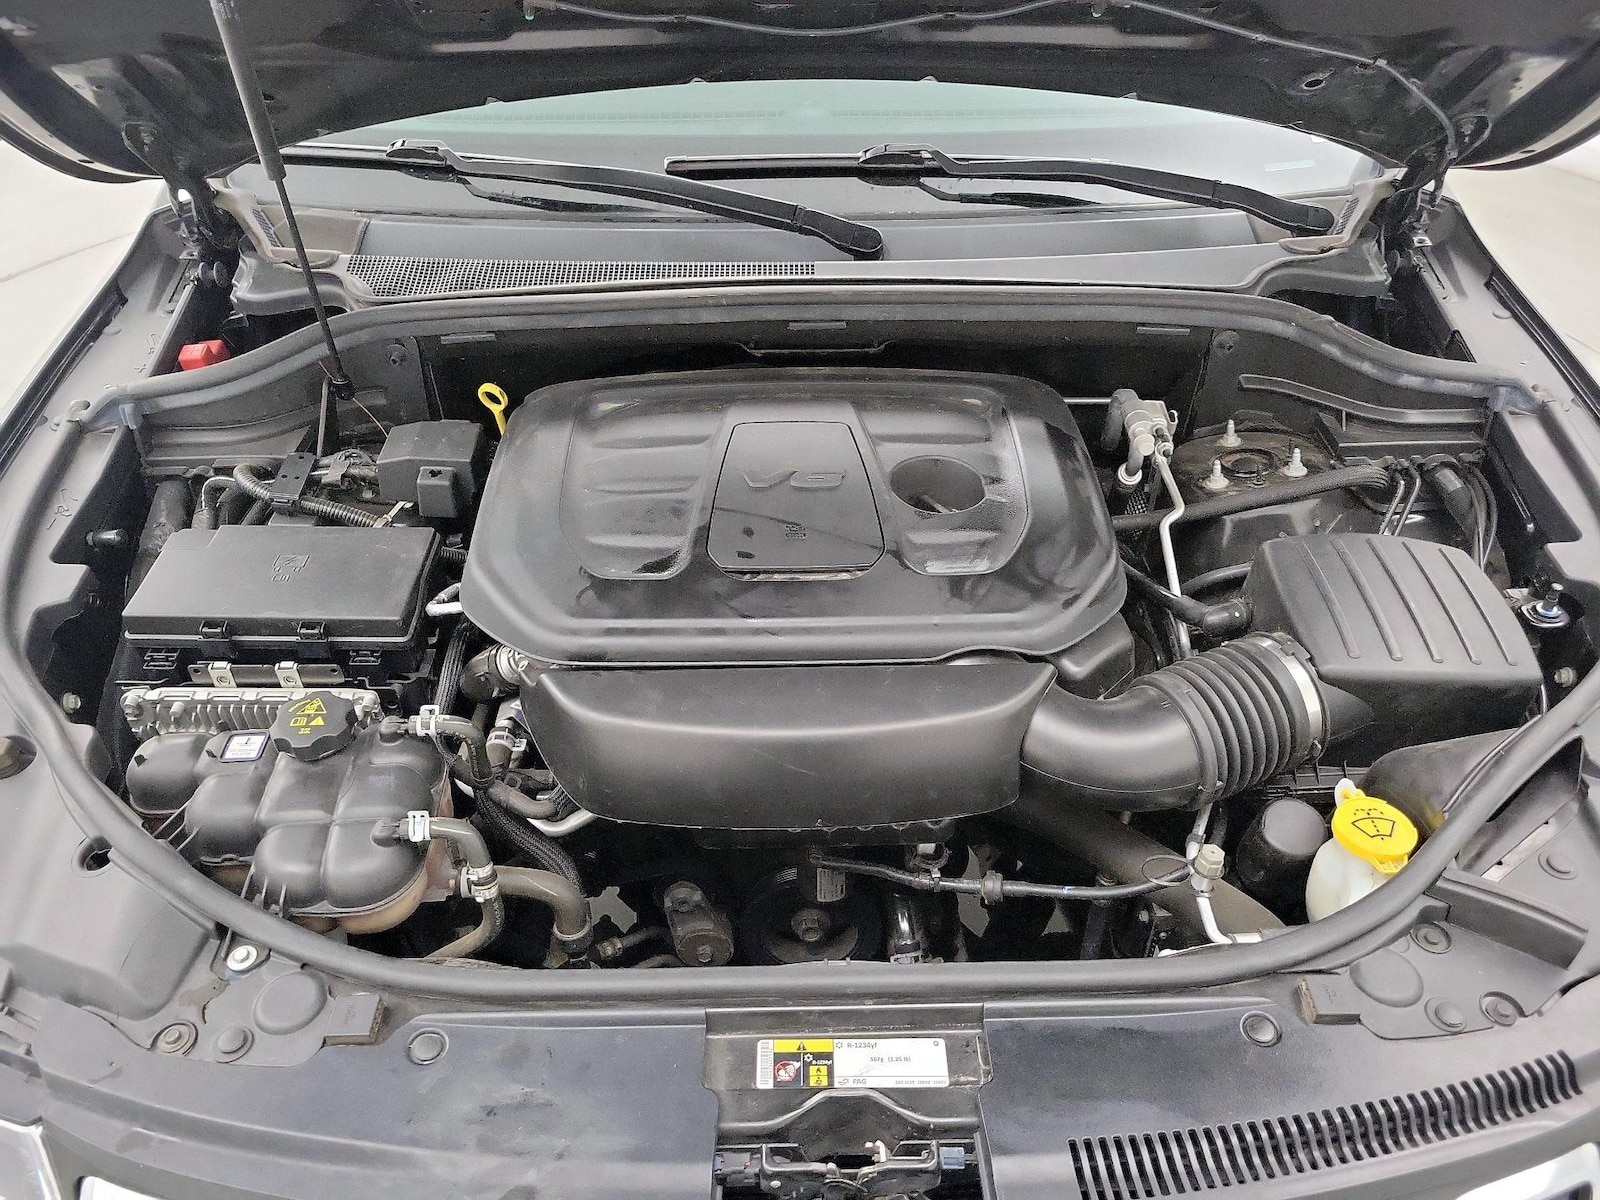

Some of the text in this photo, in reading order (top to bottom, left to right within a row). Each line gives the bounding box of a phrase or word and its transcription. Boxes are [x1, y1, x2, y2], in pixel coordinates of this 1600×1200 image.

[741, 468, 844, 491] V6
[846, 1041, 878, 1050] R-1234yf
[887, 1055, 903, 1063] (1.25
